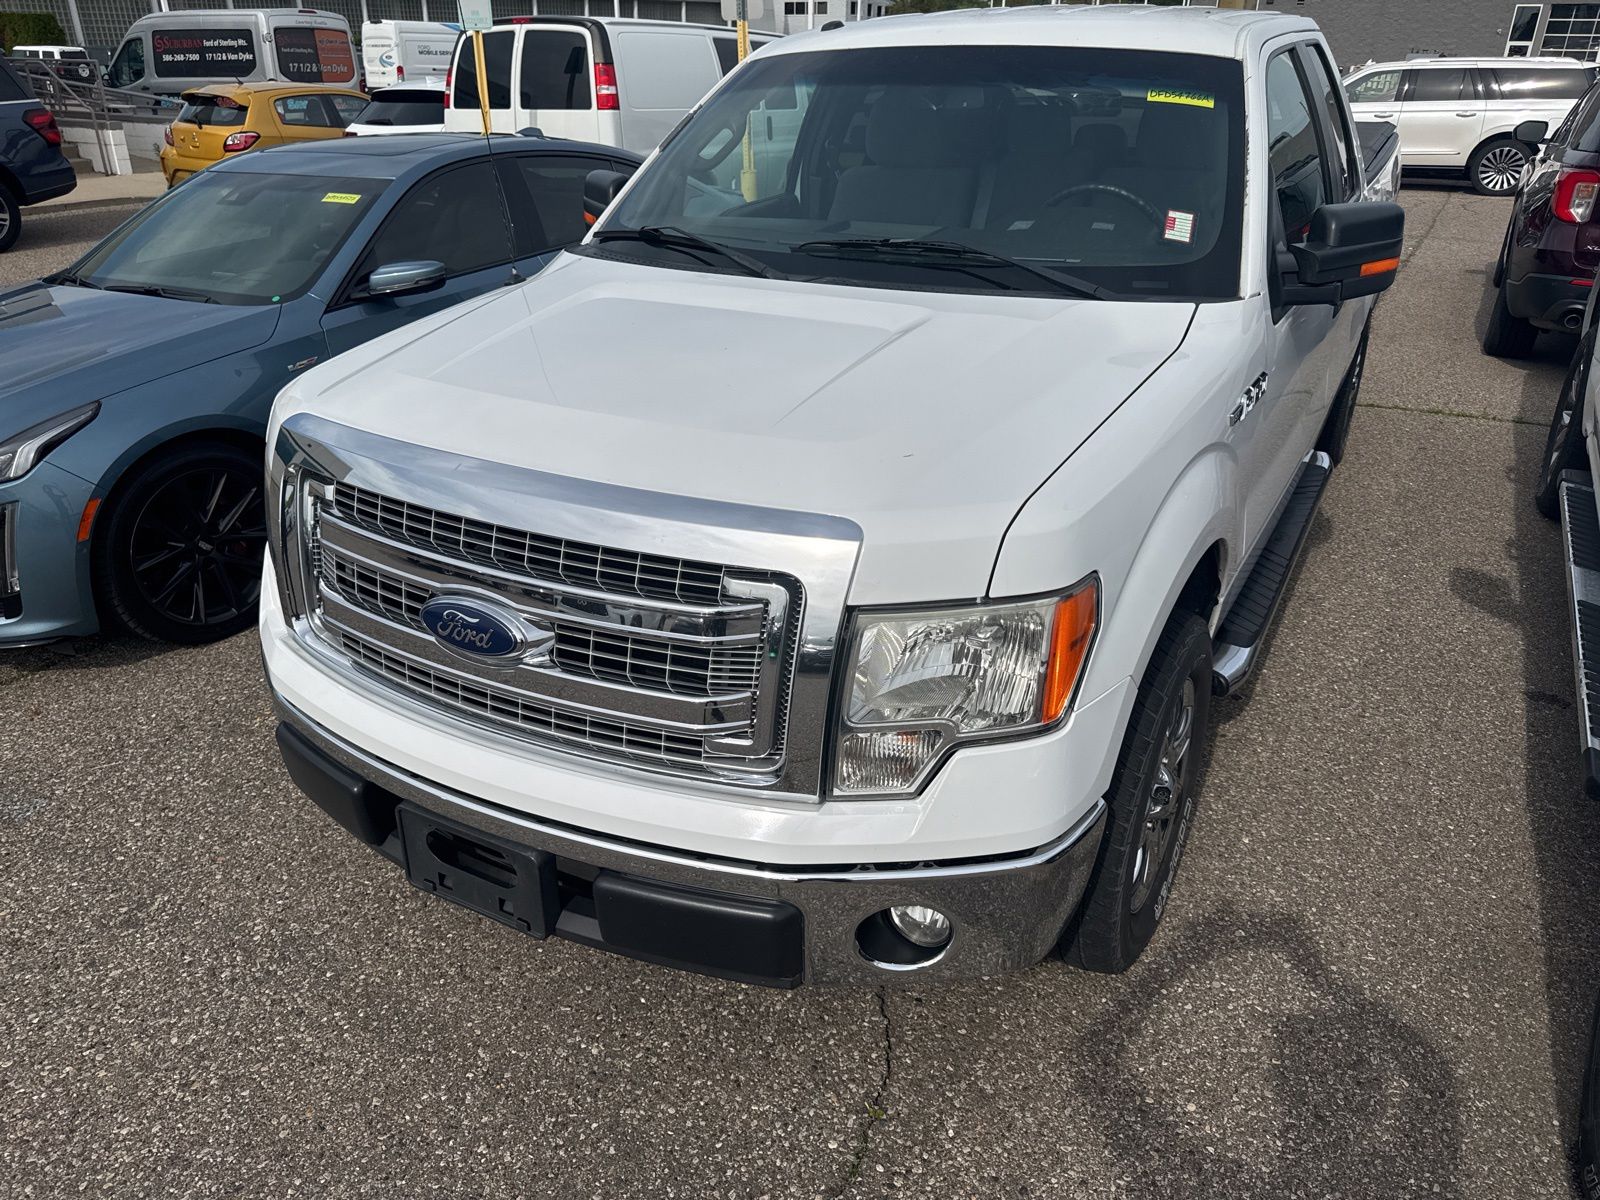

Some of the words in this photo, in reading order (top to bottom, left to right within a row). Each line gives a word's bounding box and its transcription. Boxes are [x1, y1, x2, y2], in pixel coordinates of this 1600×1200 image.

[203, 39, 214, 47] Ford
[213, 39, 219, 47] of
[219, 39, 238, 48] Sterling
[162, 53, 200, 62] 586-268-7500
[205, 53, 212, 61] 17
[213, 53, 221, 61] 1/2
[222, 53, 227, 61] &
[238, 52, 253, 62] Dyke
[289, 63, 298, 72] 17
[300, 63, 311, 73] 1/2
[312, 63, 318, 73] &
[332, 64, 348, 74] Dyke
[437, 609, 493, 649] Ford
